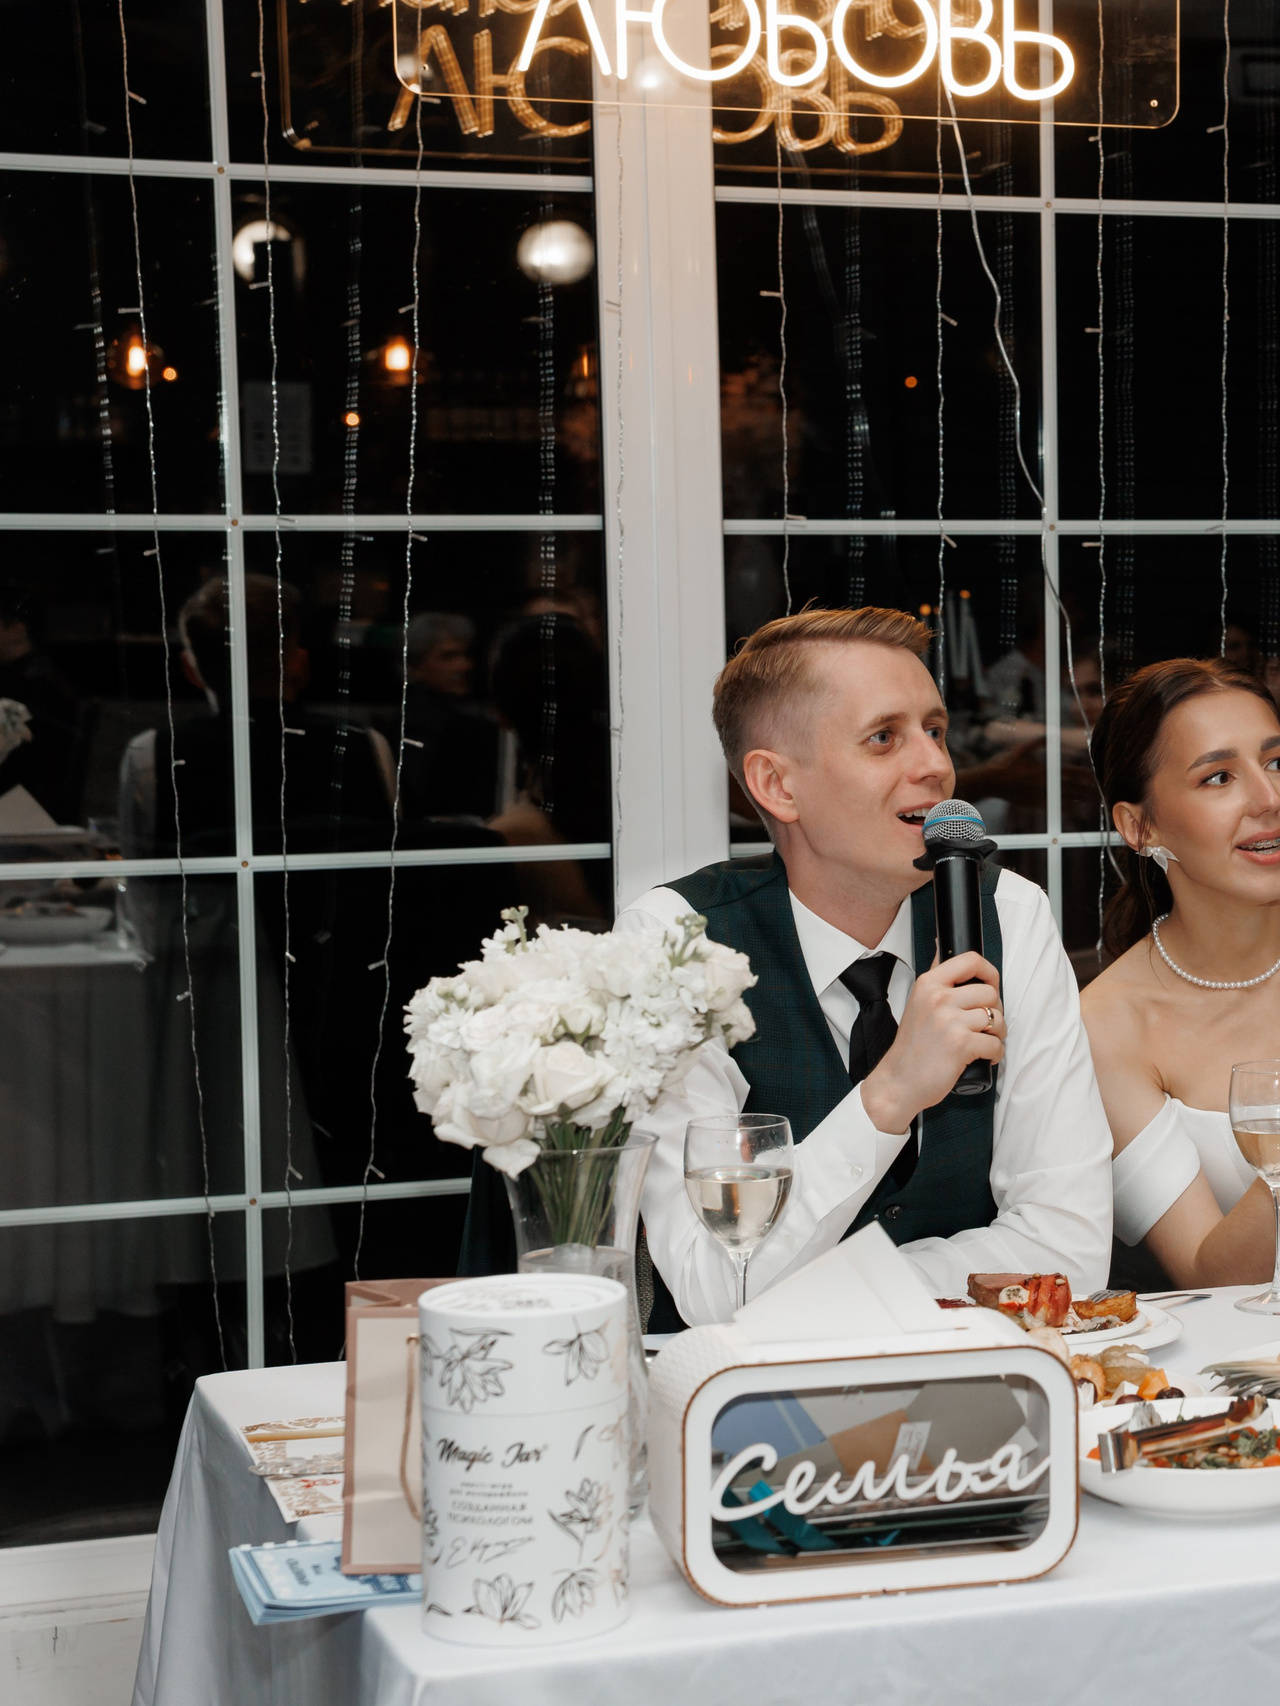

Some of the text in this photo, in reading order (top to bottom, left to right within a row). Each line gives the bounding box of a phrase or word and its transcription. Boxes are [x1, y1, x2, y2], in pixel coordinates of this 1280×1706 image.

[437, 1438, 542, 1472] Magic Jar
[711, 1443, 1052, 1522] Семья
